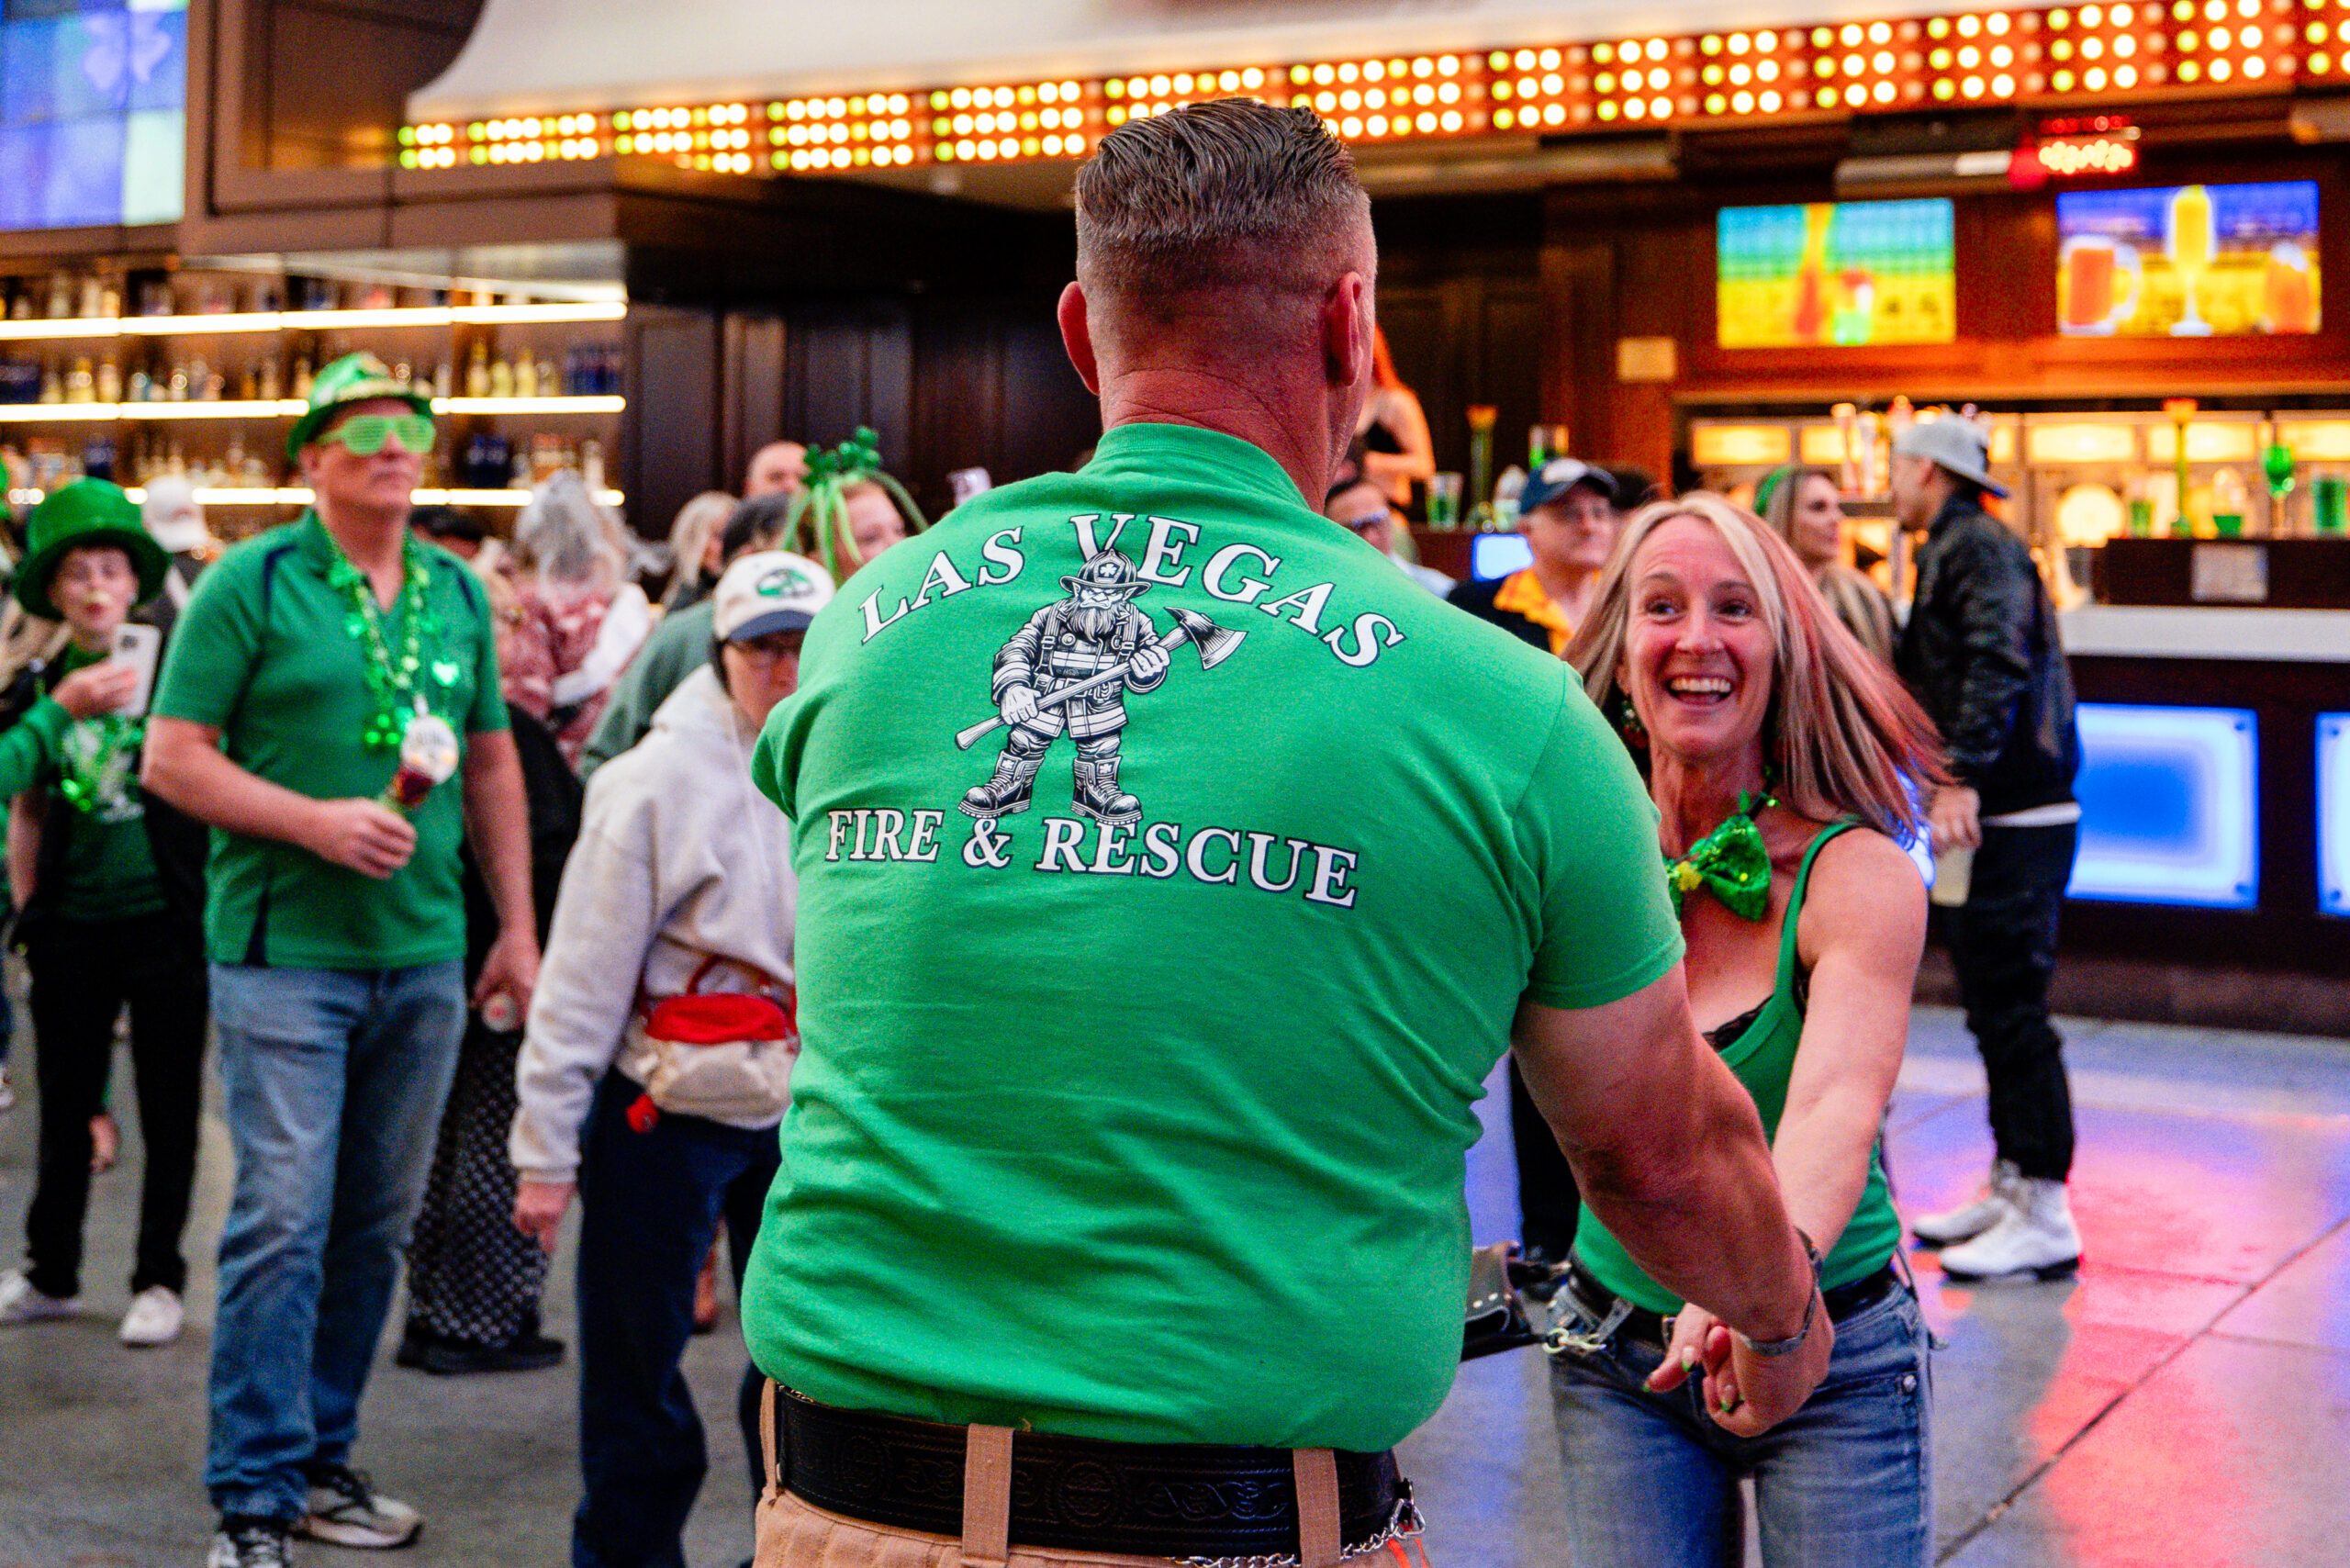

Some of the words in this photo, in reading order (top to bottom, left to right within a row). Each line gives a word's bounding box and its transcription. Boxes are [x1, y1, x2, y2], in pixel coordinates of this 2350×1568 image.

[859, 524, 1027, 646] LAS
[1068, 512, 1406, 669] VEGAS
[825, 808, 945, 863] FIRE
[960, 816, 1013, 869] &
[1035, 816, 1360, 910] RESCUE
